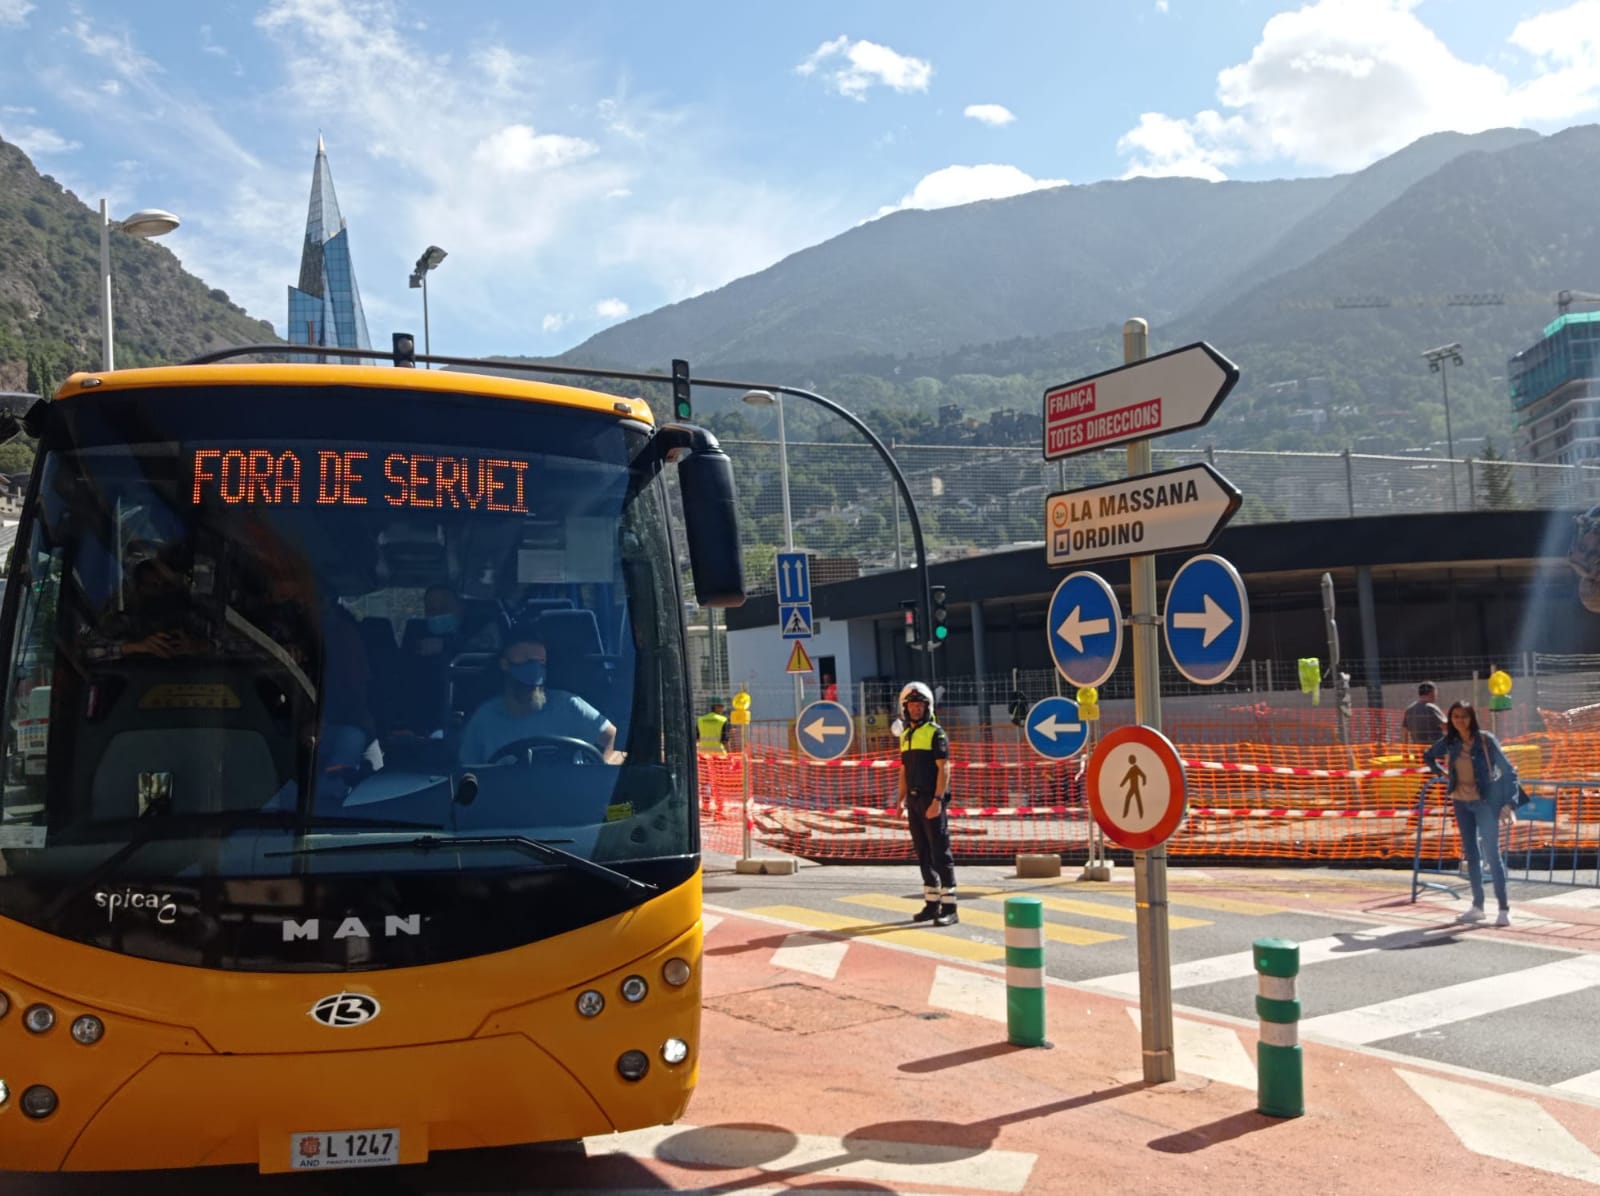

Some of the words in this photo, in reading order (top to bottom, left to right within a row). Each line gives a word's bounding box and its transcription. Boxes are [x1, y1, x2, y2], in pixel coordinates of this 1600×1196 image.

[1050, 387, 1094, 415] FRANÇA
[1050, 425, 1083, 449] TOTES
[1087, 403, 1160, 440] DIRECCIONS
[193, 449, 301, 505] FORA
[316, 450, 370, 506] DE
[384, 453, 530, 514] SERVEI
[1070, 500, 1092, 523] LA
[1099, 479, 1198, 519] MASSANA
[1072, 520, 1144, 551] ORDINO
[282, 913, 421, 943] MAN
[326, 1135, 338, 1158] L
[345, 1132, 393, 1157] 1247
[299, 1159, 320, 1168] AND
